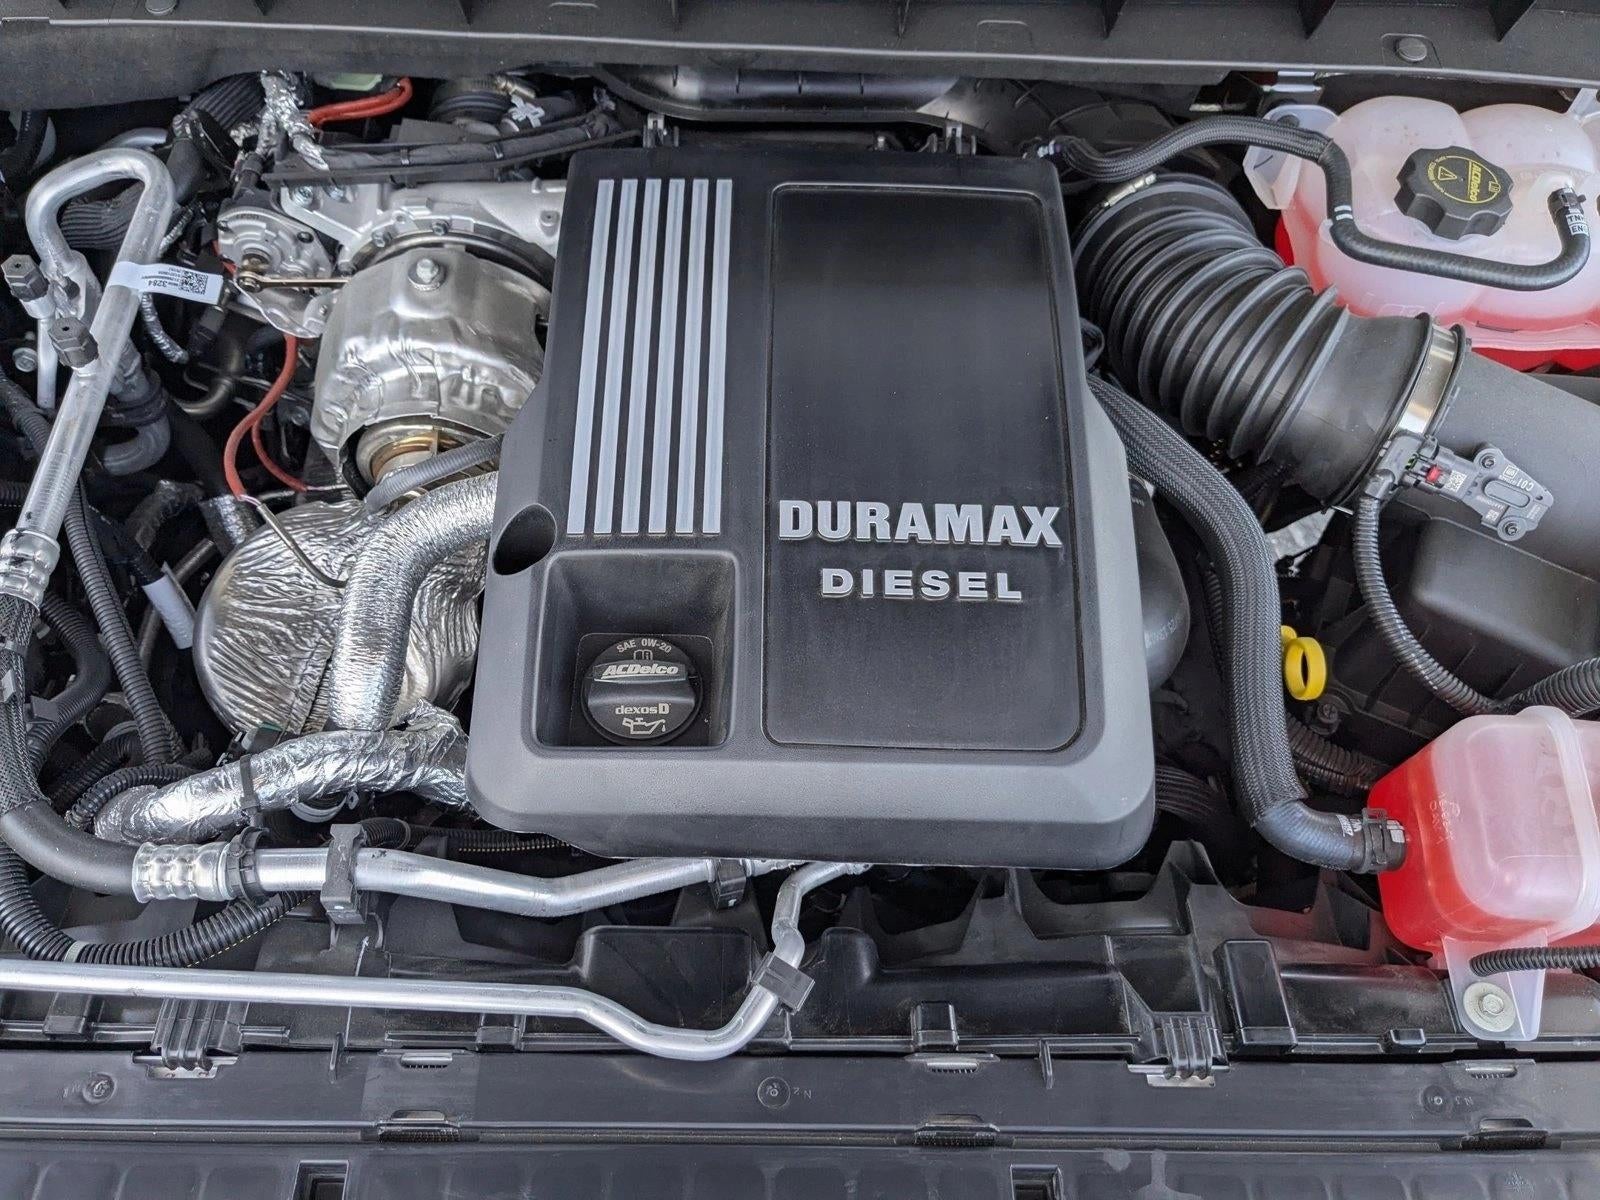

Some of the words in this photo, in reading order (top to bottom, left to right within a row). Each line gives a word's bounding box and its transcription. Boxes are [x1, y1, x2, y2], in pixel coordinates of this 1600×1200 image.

[778, 499, 1063, 548] DURAMAX
[821, 567, 1023, 602] DIESEL
[616, 639, 637, 653] SAE
[641, 638, 672, 653] 0W-20
[601, 663, 679, 677] ACDelco
